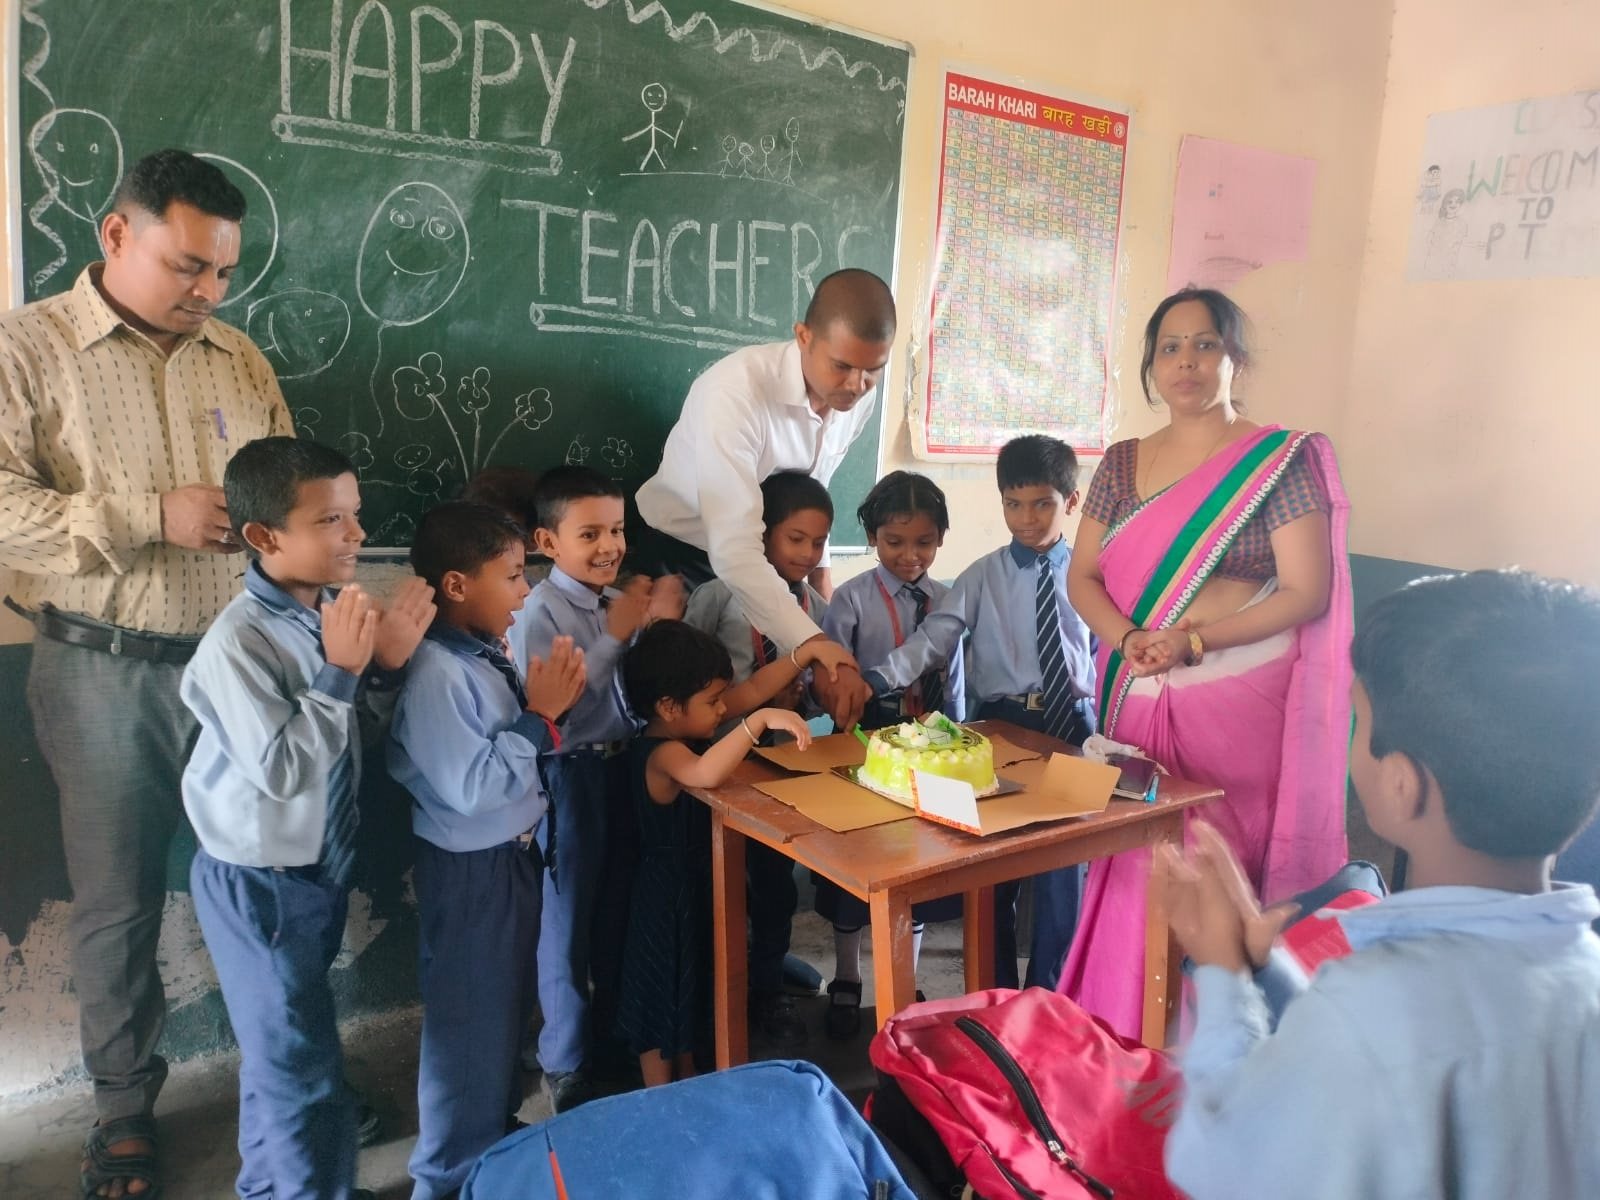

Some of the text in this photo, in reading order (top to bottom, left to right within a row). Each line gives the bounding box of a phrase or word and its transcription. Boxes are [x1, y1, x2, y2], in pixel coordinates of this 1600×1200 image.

[280, 0, 576, 146] HAPPY
[949, 83, 1037, 119] BARAH KHARI
[1041, 106, 1076, 128] बारह
[1082, 115, 1112, 136] खड़ी
[1466, 147, 1600, 202] WELCOM
[1517, 196, 1554, 221] TO
